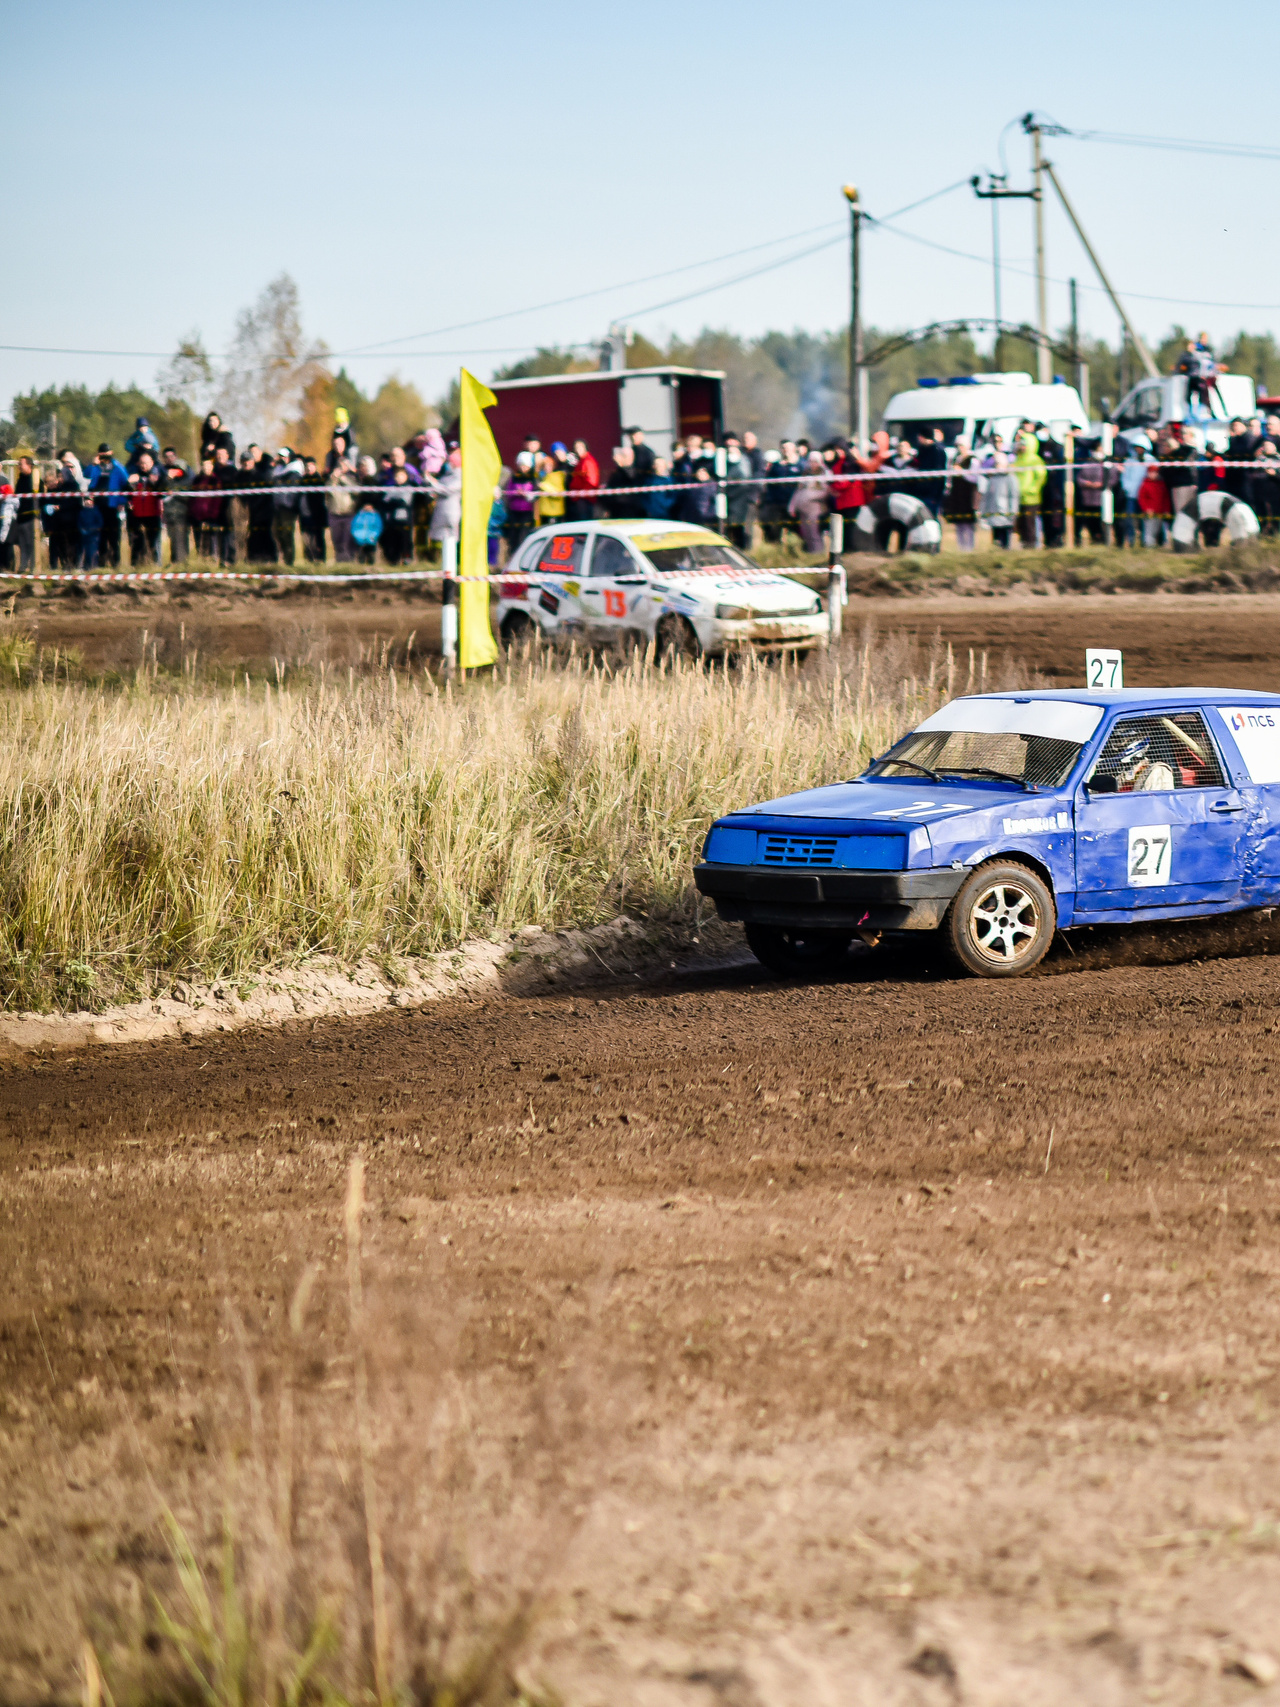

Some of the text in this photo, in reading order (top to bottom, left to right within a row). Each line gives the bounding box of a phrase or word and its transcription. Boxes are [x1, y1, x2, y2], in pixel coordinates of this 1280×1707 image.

[550, 536, 575, 560] 13
[602, 589, 627, 618] 13
[1091, 658, 1119, 688] 27
[1247, 715, 1276, 728] ПСБ
[871, 801, 974, 817] 27
[1131, 837, 1168, 876] 27
